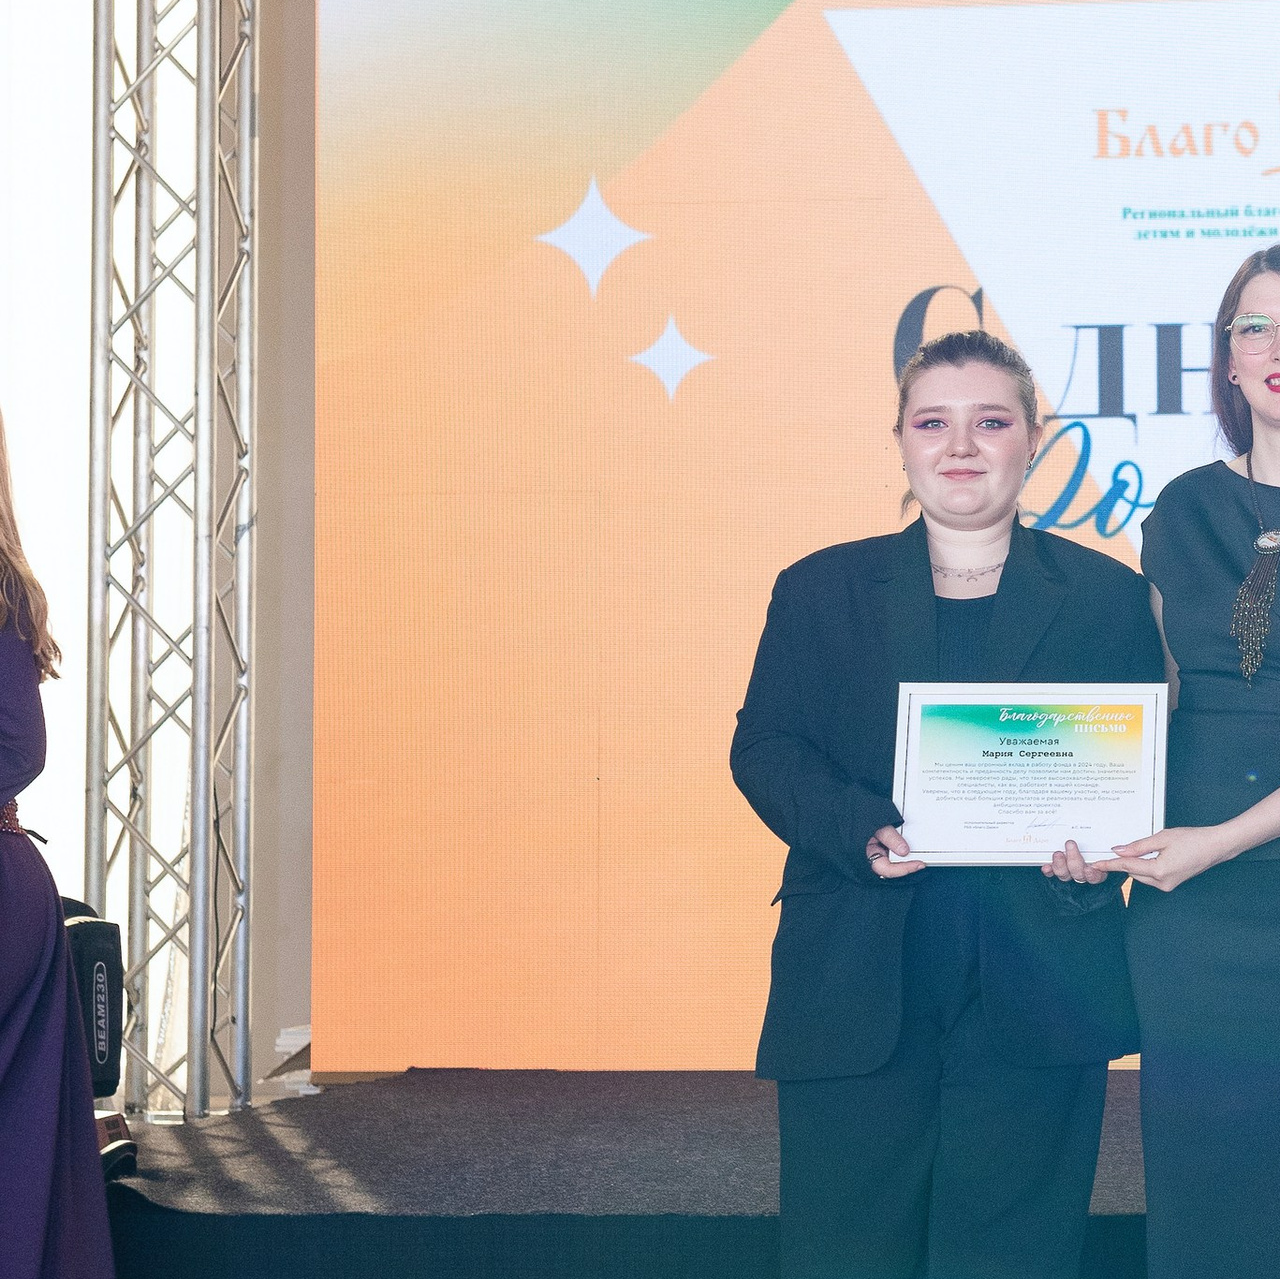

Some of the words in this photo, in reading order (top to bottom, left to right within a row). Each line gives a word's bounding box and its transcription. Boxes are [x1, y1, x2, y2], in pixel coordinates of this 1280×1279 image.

[1092, 108, 1260, 159] Благо
[1122, 206, 1239, 219] Региональный
[1134, 229, 1180, 240] детям
[1185, 229, 1195, 238] и
[1200, 225, 1278, 238] молодёжи
[998, 706, 1134, 728] Благодарственное
[999, 737, 1059, 746] Уважаемая
[982, 750, 1013, 758] Мария
[1019, 750, 1074, 759] Сергеевна
[96, 973, 106, 1051] BEAM230
